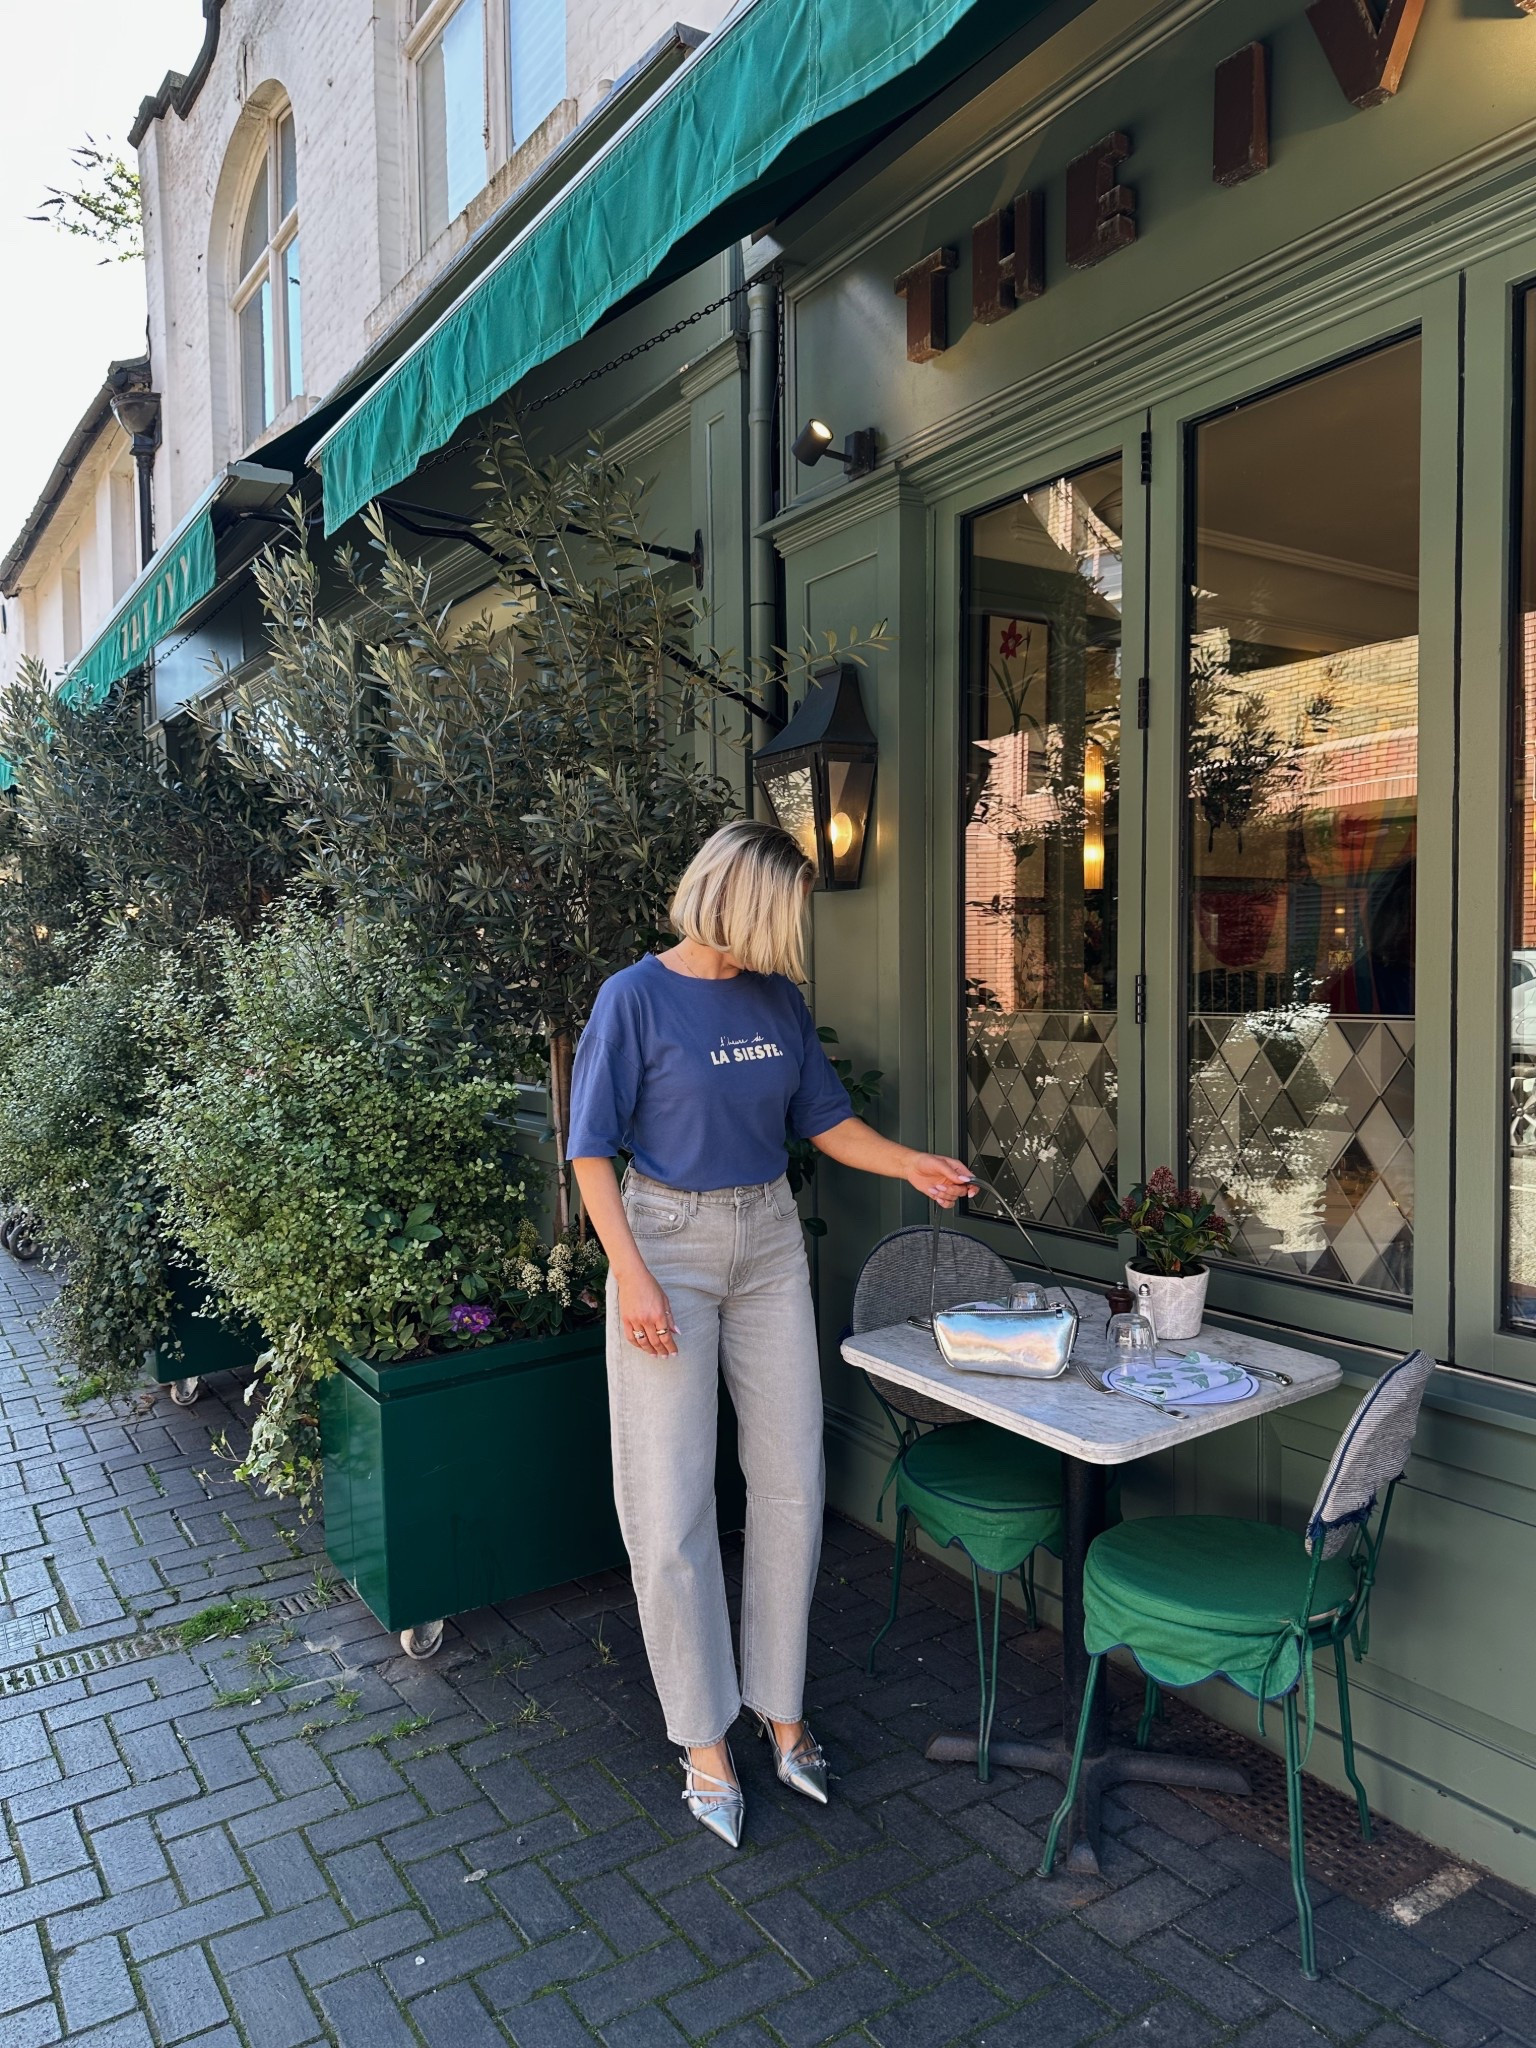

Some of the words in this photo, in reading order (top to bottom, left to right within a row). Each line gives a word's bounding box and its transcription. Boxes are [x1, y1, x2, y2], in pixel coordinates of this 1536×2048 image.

[894, 130, 1137, 364] THE
[1212, 0, 1536, 188] IV
[710, 1049, 731, 1066] LA
